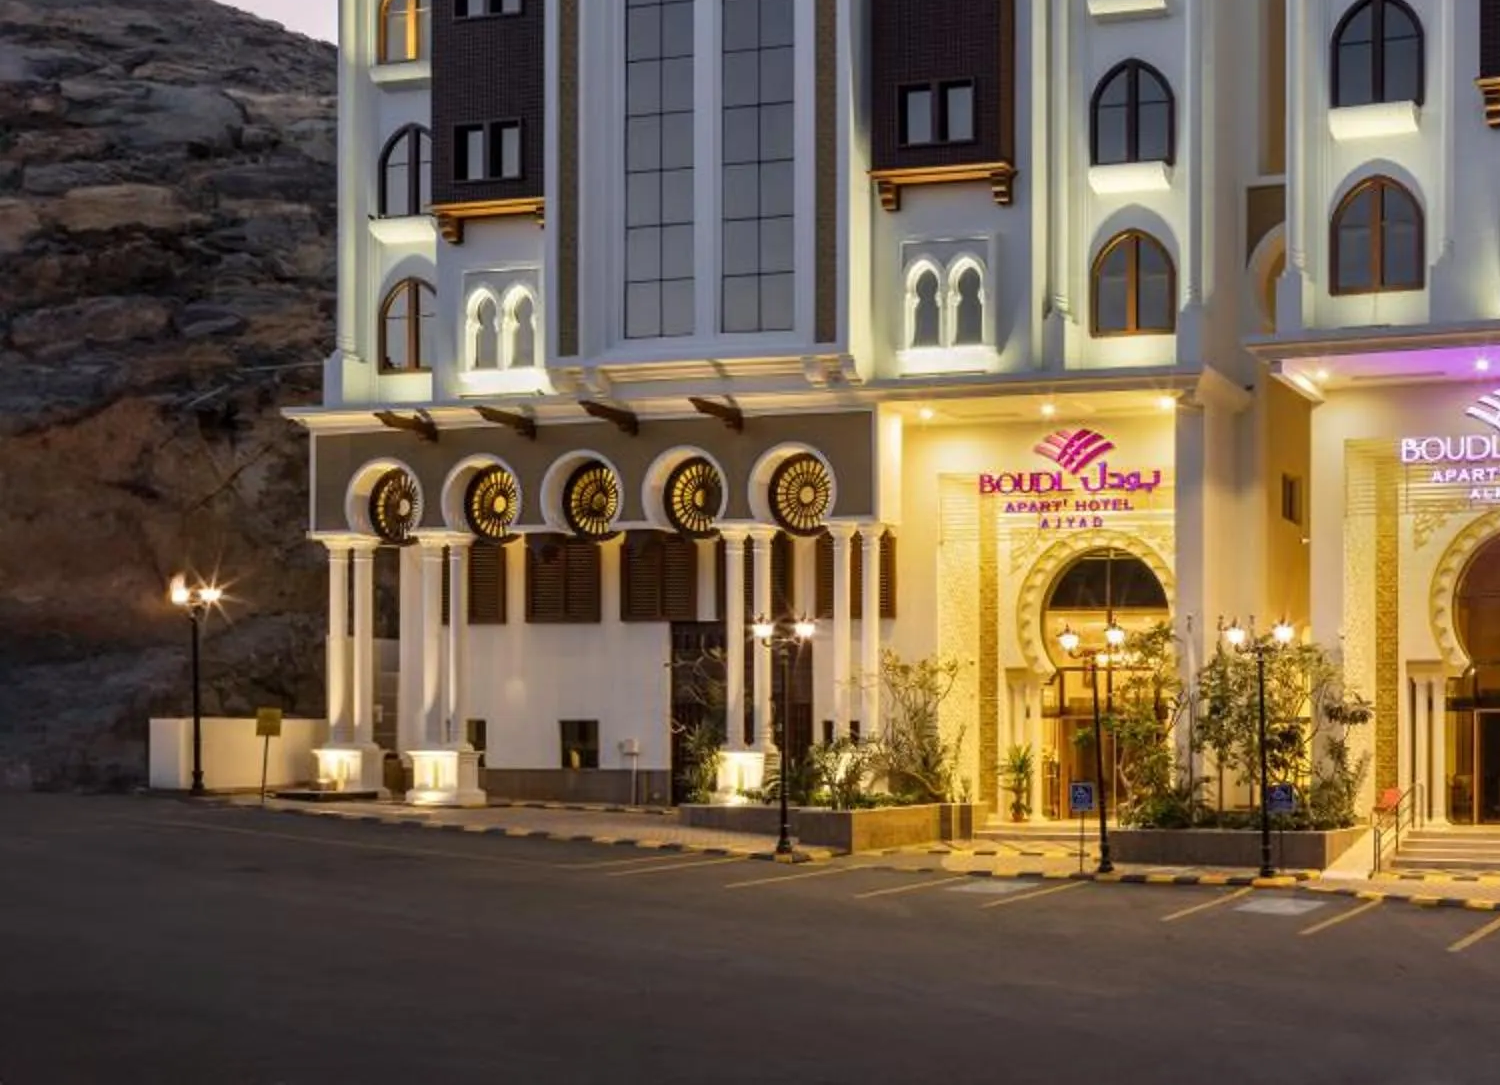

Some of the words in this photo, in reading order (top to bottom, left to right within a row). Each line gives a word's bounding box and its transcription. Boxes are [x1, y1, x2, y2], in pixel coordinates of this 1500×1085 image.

[979, 472, 1073, 494] BOUDL
[1080, 461, 1161, 492] بودل
[1075, 499, 1134, 511] HOTEL
[1040, 516, 1103, 529] AJYAD
